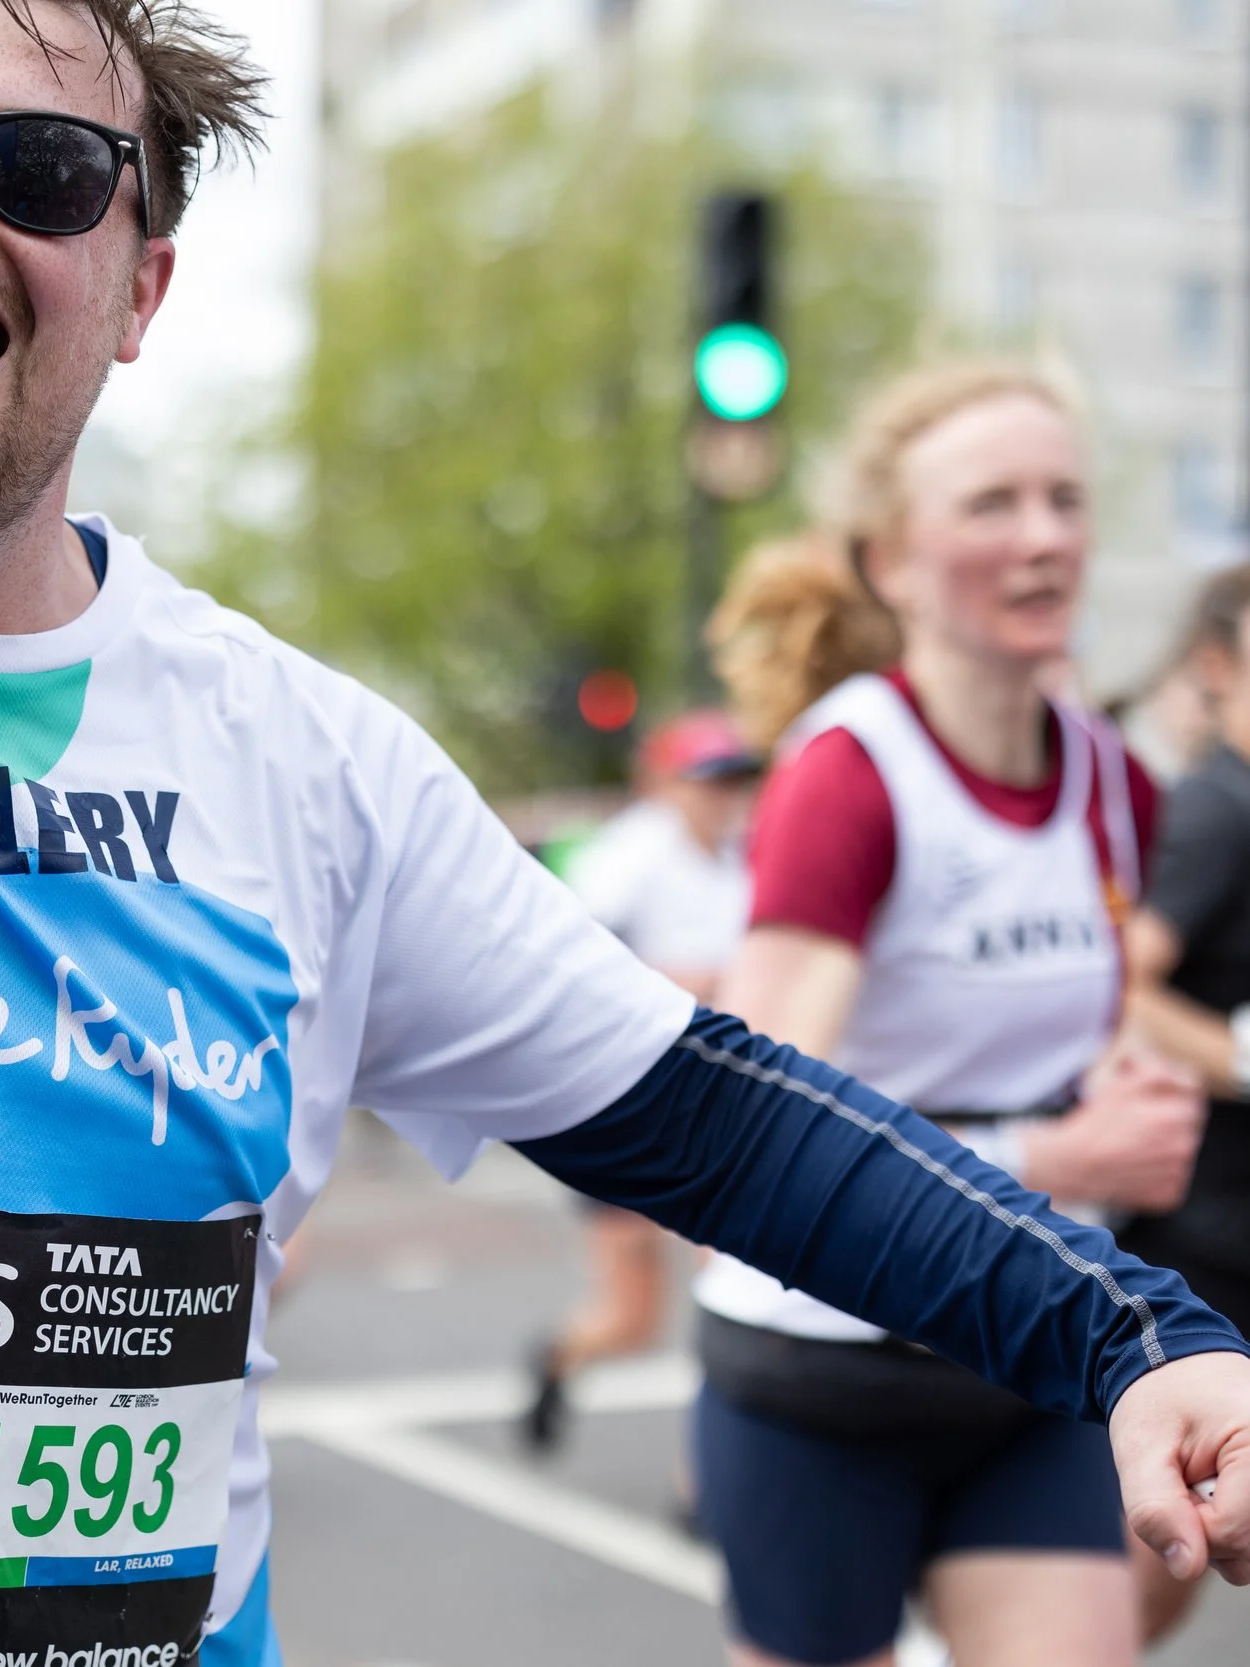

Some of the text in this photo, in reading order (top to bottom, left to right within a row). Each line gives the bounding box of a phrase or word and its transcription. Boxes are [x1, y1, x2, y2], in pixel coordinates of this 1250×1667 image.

[49, 954, 280, 1147] Ryder
[46, 1242, 143, 1277] TATA
[40, 1283, 240, 1317] CONSULTANCY
[33, 1323, 174, 1356] SERVICES
[94, 1554, 174, 1574] LAR, RELAXED
[40, 1642, 180, 1667] balance
